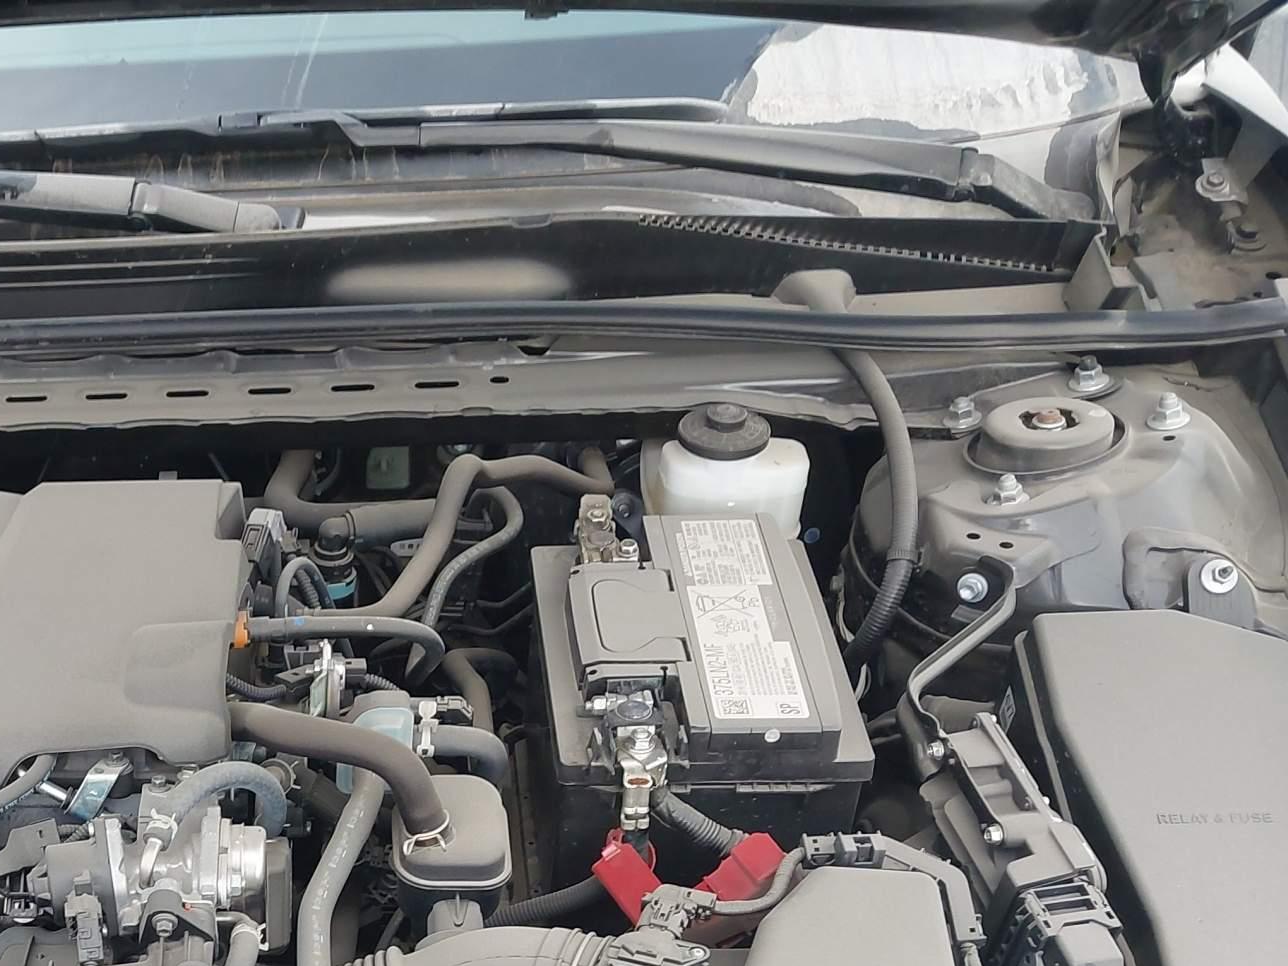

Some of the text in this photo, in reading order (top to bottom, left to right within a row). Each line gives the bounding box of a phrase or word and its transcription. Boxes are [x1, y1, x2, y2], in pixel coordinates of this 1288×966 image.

[779, 703, 801, 715] SP
[1156, 813, 1209, 825] RELAY
[1229, 812, 1273, 825] FUSE
